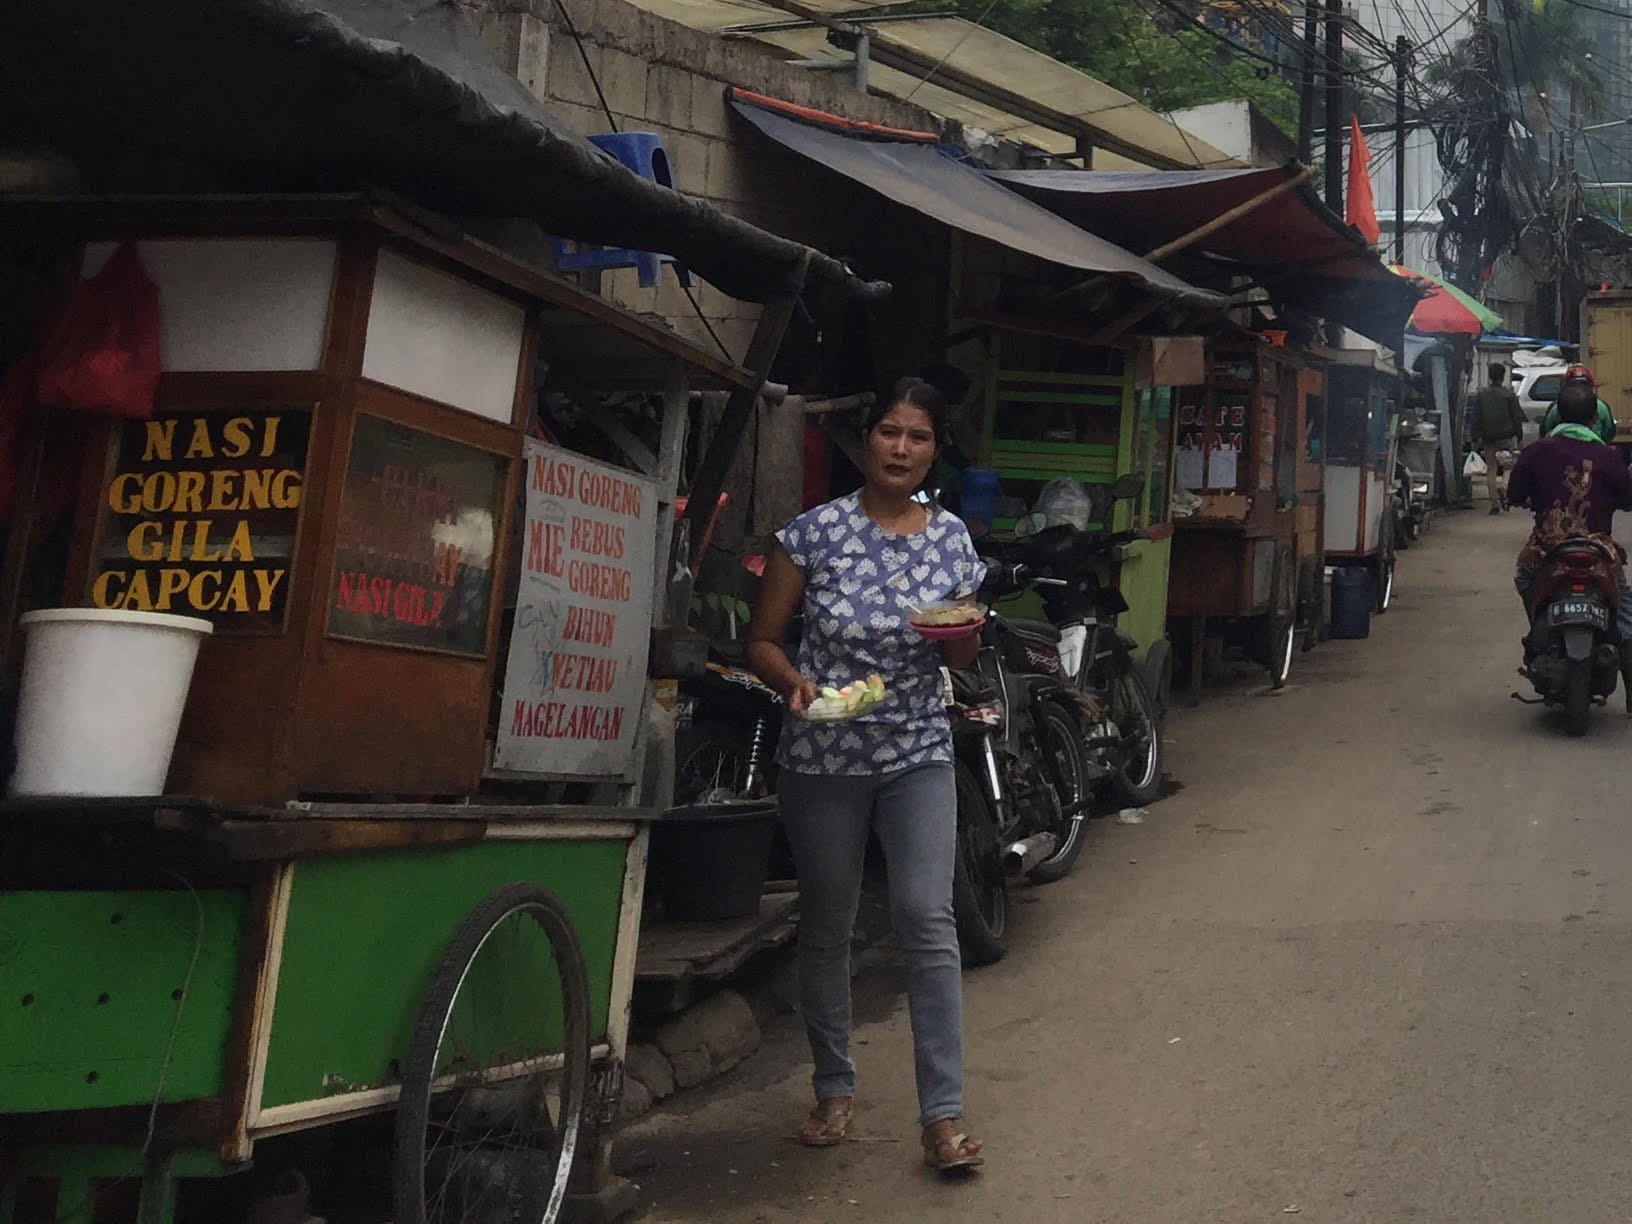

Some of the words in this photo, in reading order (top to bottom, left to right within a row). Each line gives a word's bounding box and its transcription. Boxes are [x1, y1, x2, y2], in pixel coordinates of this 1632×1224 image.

[141, 416, 281, 463] NASI
[108, 468, 305, 515] GORENG
[532, 455, 577, 500] NASI
[577, 463, 642, 520] GORENG
[126, 519, 255, 563] GILA
[527, 518, 566, 579] MIE
[568, 515, 626, 560] REBUS
[91, 567, 286, 613] CAPCAY
[336, 571, 392, 618] NASI
[567, 559, 633, 604] GORENG
[561, 605, 617, 649] BIHUN
[510, 699, 626, 743] MAGELANGAN
